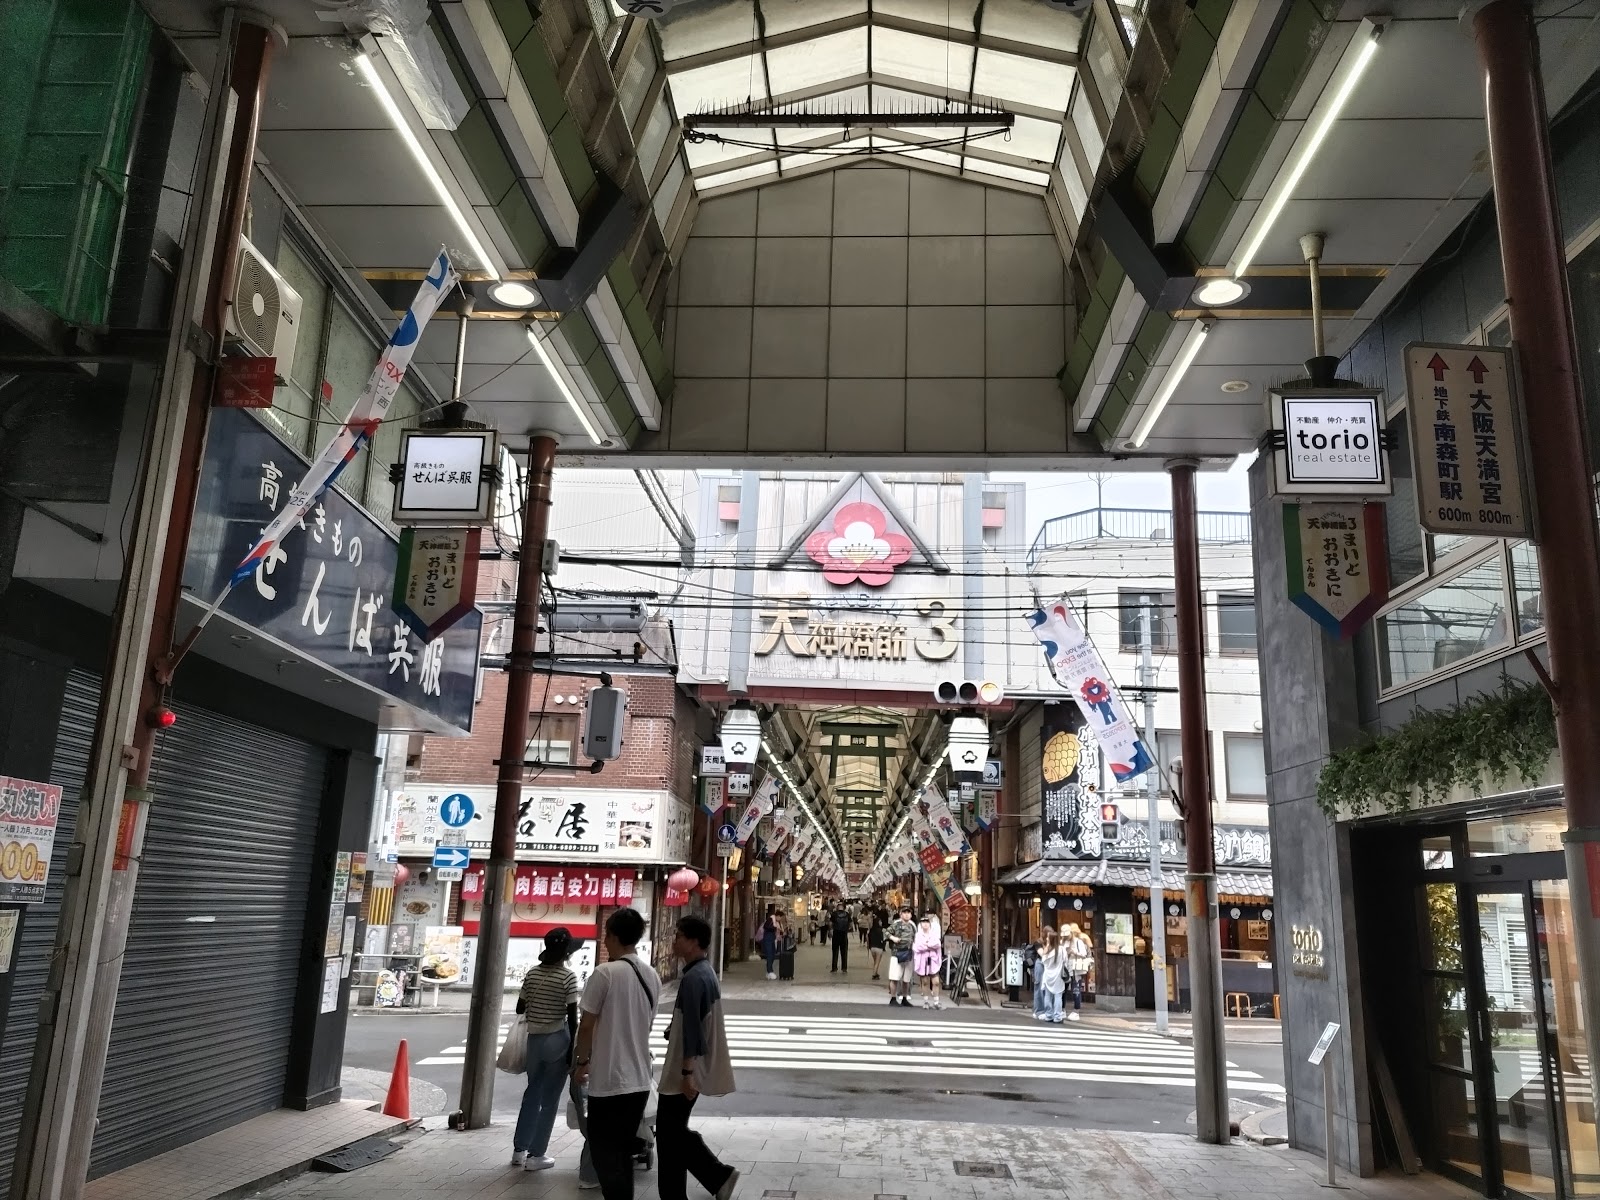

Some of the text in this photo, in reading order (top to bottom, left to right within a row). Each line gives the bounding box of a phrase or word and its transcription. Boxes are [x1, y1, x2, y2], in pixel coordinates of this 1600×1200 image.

[1296, 416, 1366, 424] 不動産 仲介・売買
[1296, 429, 1369, 450] torio
[1297, 452, 1371, 463] real estate
[1433, 386, 1463, 501] 地下鉄南森町駅
[1469, 389, 1502, 505] 大阪天満宮
[412, 470, 472, 484] せんば呉服
[1438, 507, 1472, 523] 600m
[1479, 509, 1512, 525] 800m
[441, 552, 457, 589] まいど
[1323, 537, 1342, 597] おおきに
[1342, 533, 1361, 577] まいど
[423, 557, 440, 607] おおきに
[755, 596, 960, 661] 天神橋筋3
[0, 840, 47, 882] 00円
[1215, 829, 1271, 864] 門鯛
[1010, 950, 1019, 984] たいやき
